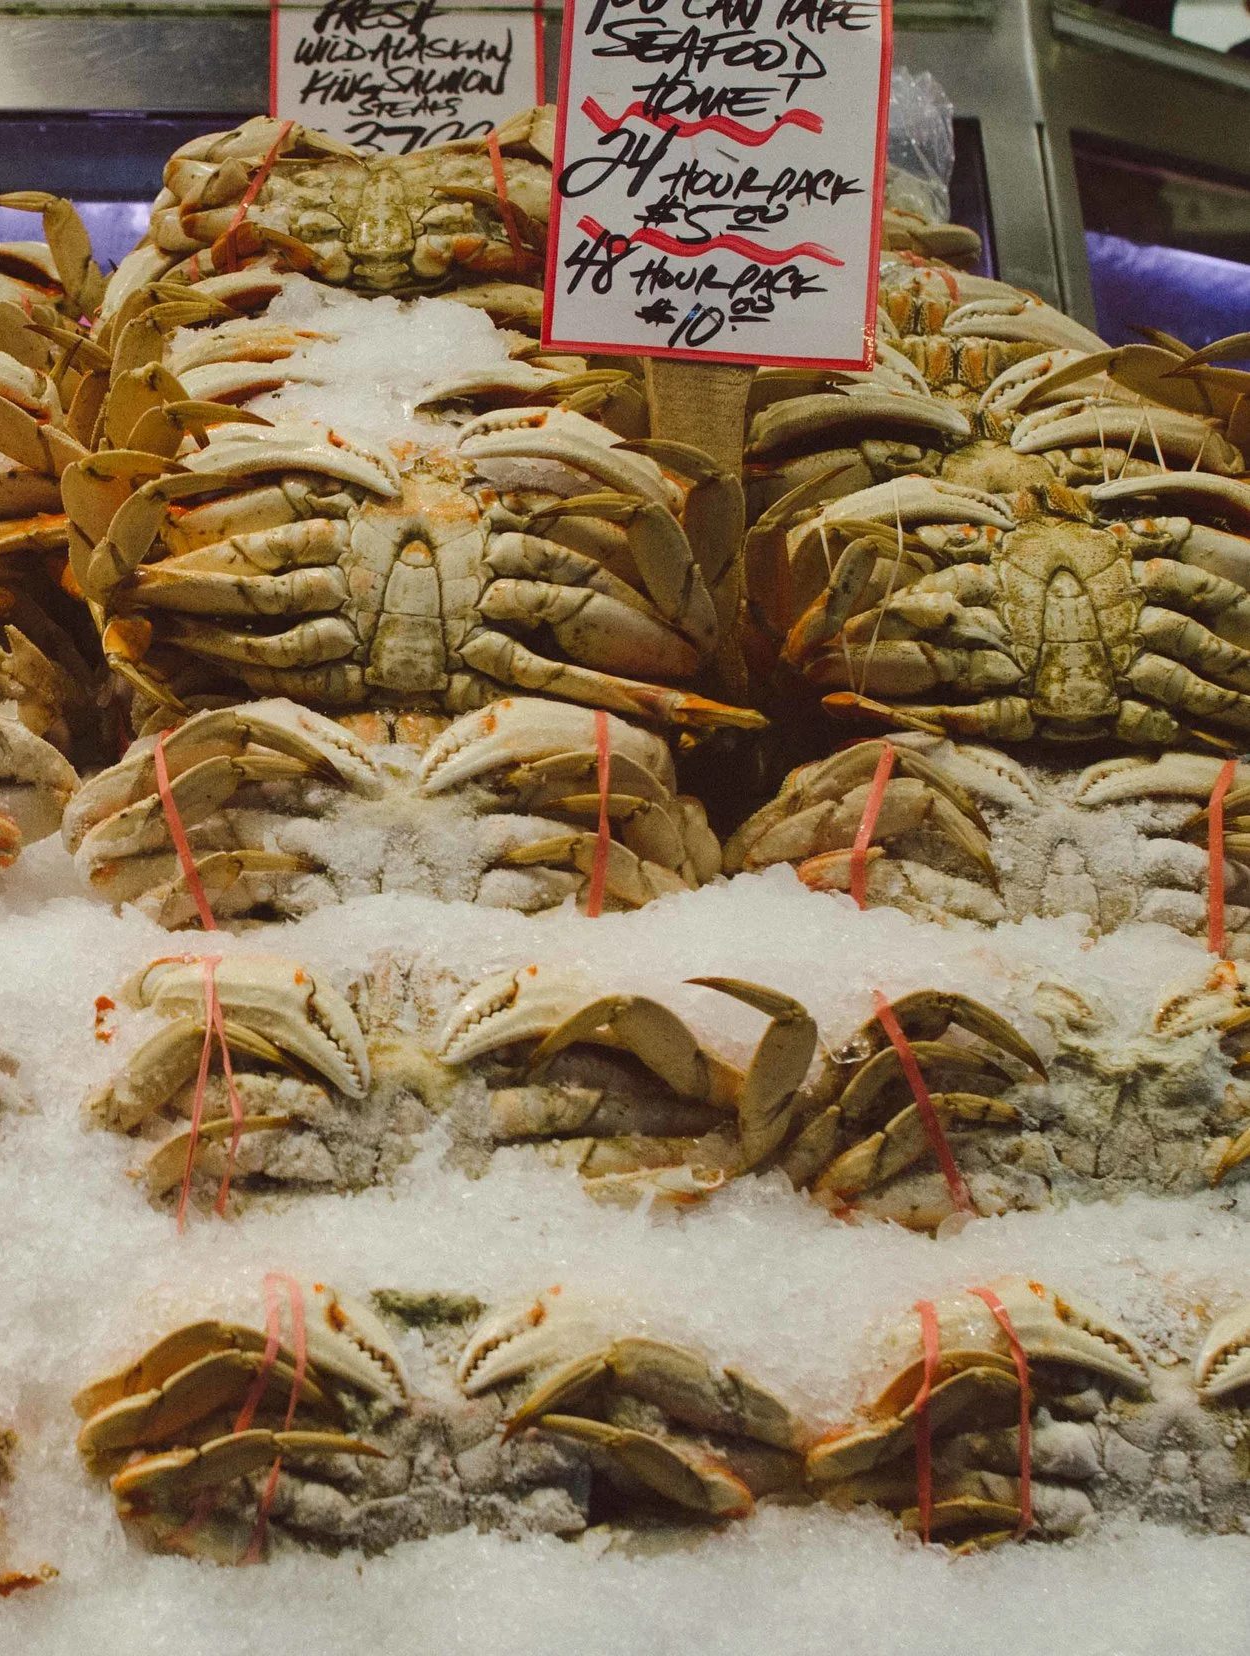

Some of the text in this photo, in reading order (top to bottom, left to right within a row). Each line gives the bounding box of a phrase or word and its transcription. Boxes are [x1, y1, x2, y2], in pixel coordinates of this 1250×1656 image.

[375, 61, 510, 97] SALMON
[592, 17, 827, 78] SEAFOOD
[558, 124, 866, 206] 24 HOUR PACK
[564, 228, 829, 299] 48 HOUR PACK
